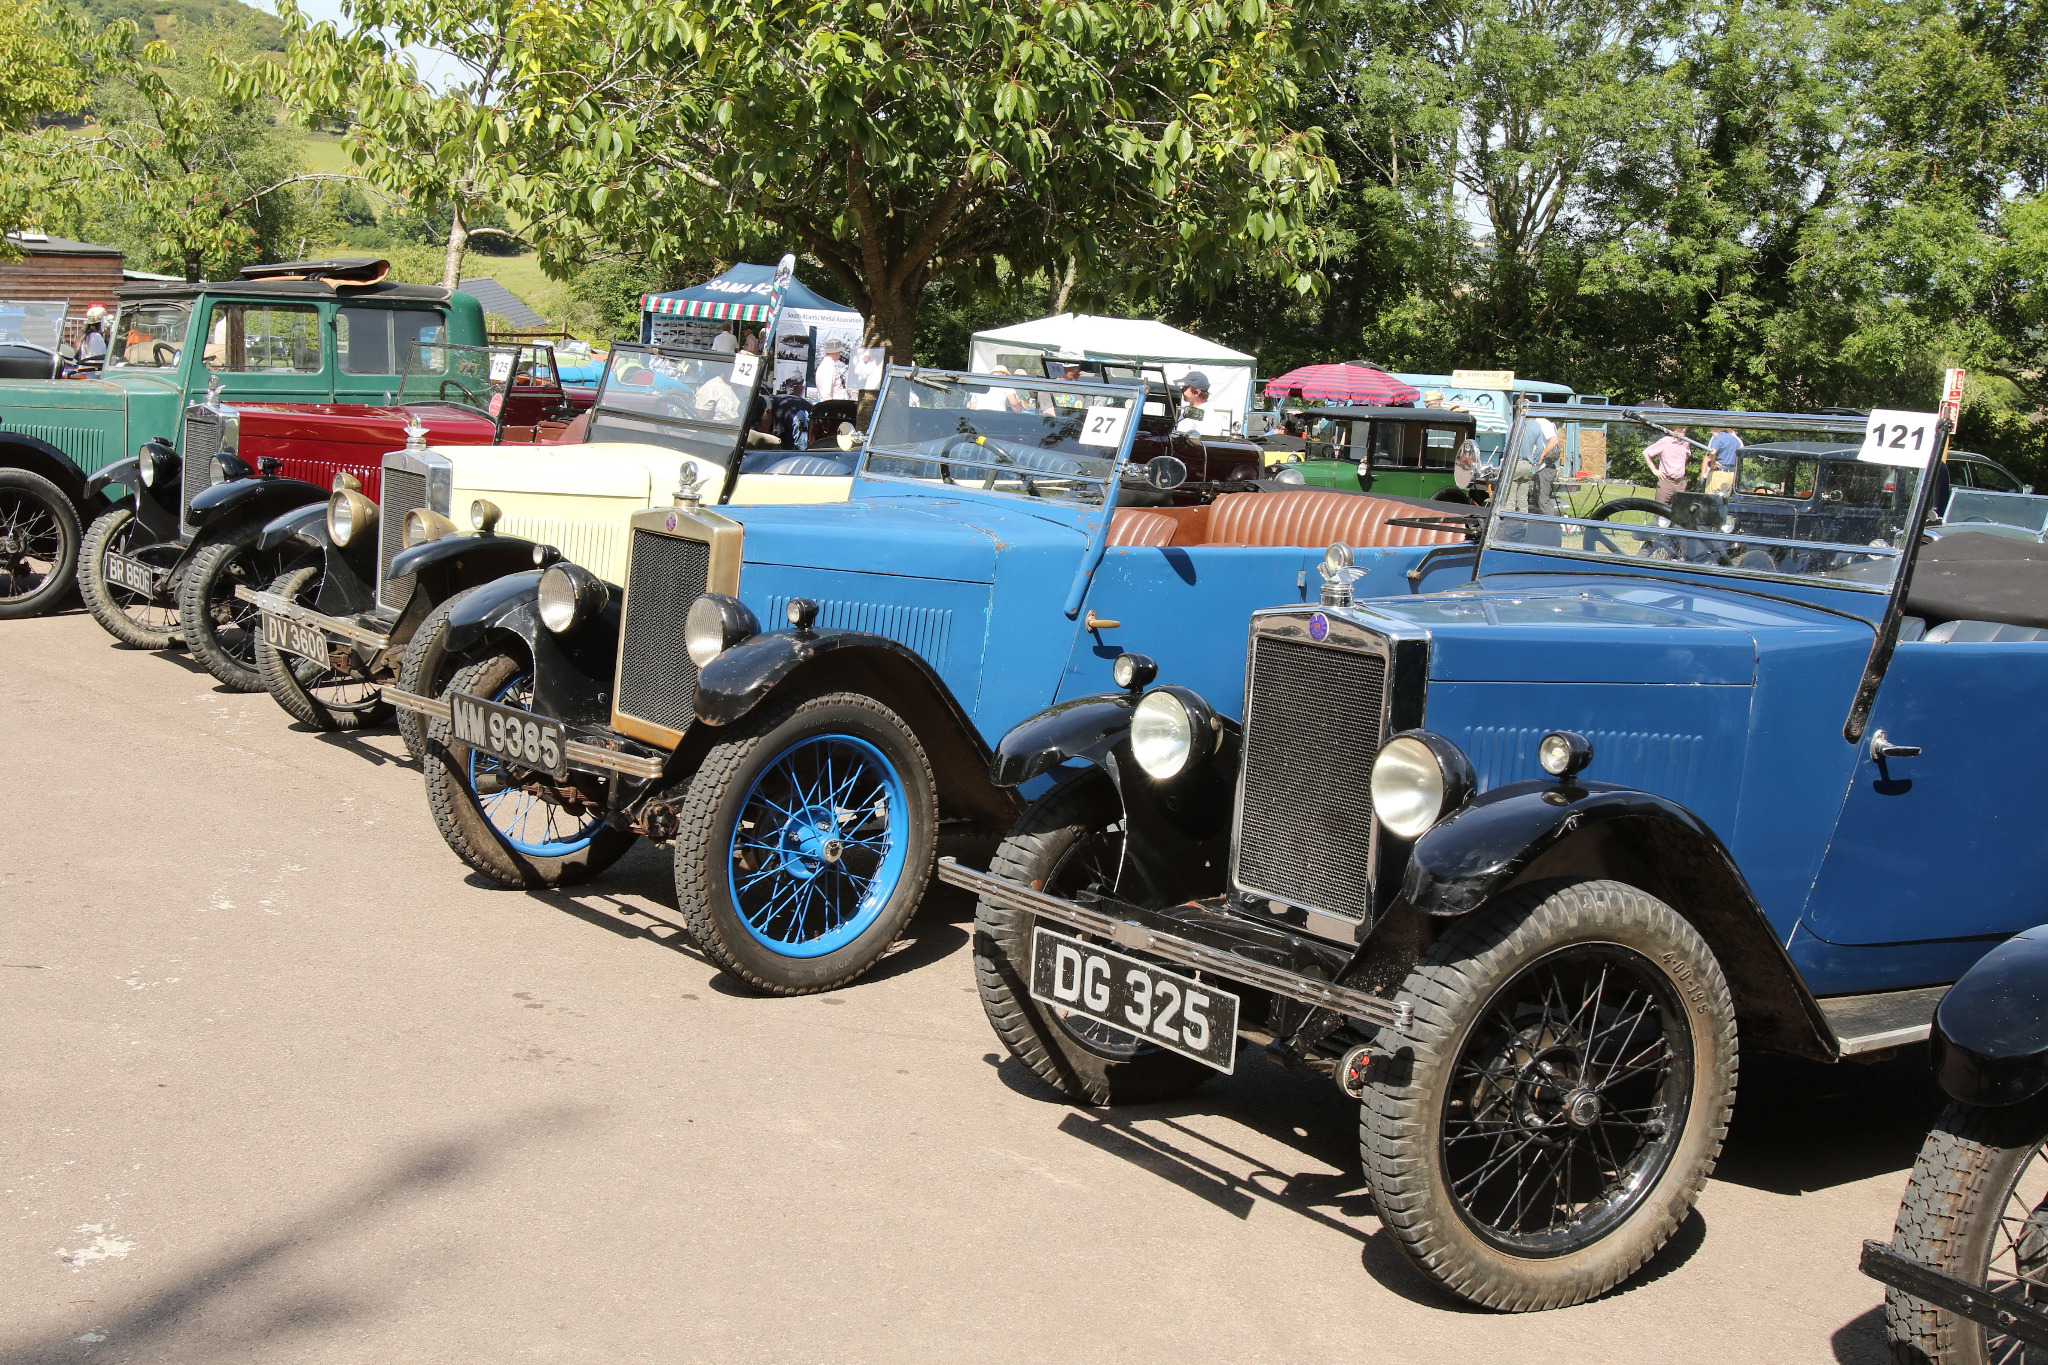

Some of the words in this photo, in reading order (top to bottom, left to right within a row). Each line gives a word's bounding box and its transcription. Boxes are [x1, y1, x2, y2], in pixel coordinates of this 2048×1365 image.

[705, 280, 753, 294] SAMA
[787, 312, 801, 320] South
[802, 313, 820, 321] Atlantic
[821, 314, 836, 322] Medal
[836, 316, 862, 324] Association
[495, 361, 508, 373] 125
[738, 362, 753, 377] 42
[1091, 415, 1117, 434] 27
[1872, 423, 1925, 451] 121
[109, 557, 124, 583] BR
[126, 563, 150, 594] 8606
[269, 616, 288, 647] DV
[290, 624, 325, 662] 3600
[489, 711, 560, 769] 9385
[1053, 943, 1112, 1013] DG
[1124, 969, 1210, 1051] 325
